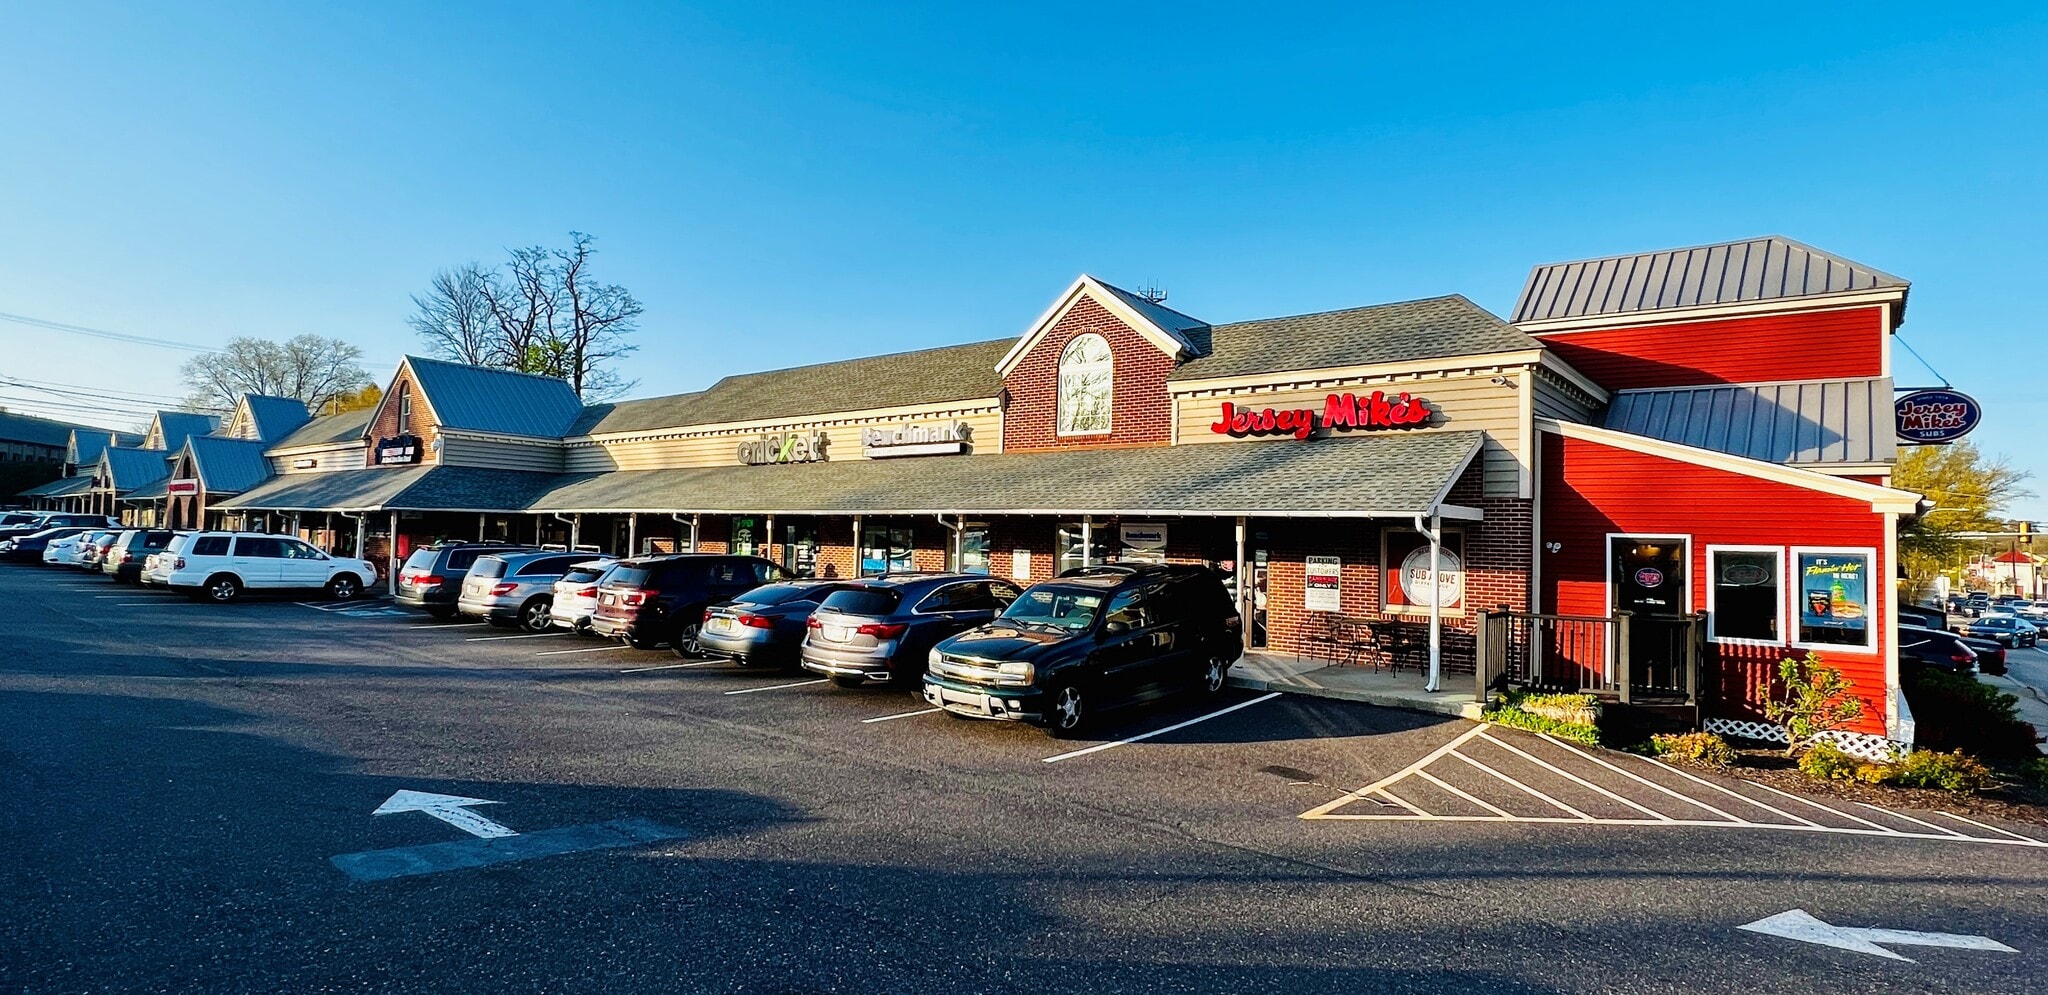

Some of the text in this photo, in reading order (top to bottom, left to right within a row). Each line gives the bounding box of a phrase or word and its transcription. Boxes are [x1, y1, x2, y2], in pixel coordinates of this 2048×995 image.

[1211, 391, 1431, 440] Jersey Mike's
[1898, 401, 1967, 418] Jersey
[1902, 414, 1967, 431] Mike's
[861, 419, 964, 446] Benchmark
[1920, 430, 1945, 438] SUBS
[738, 430, 826, 464] cricket
[1308, 557, 1338, 566] PARKING
[1307, 566, 1339, 576] CUSTOMERS
[1410, 568, 1427, 581] SUB
